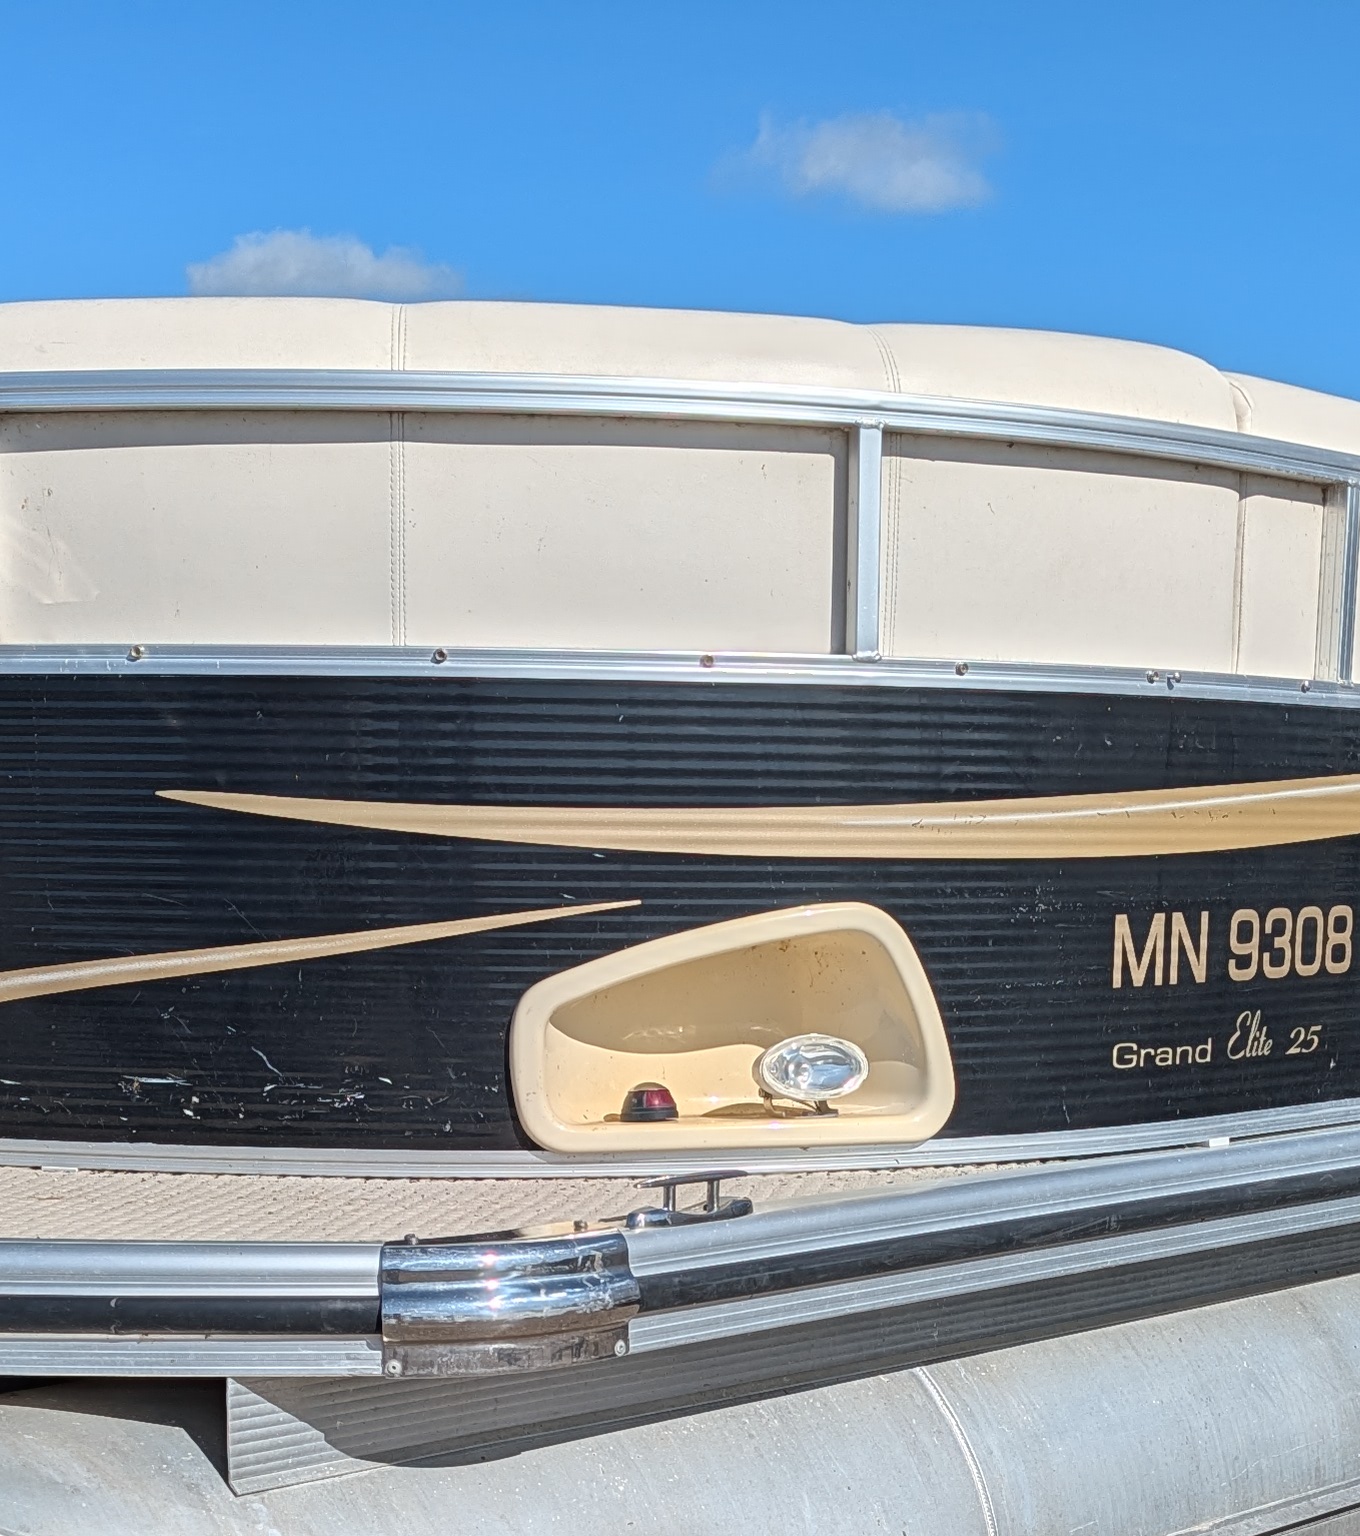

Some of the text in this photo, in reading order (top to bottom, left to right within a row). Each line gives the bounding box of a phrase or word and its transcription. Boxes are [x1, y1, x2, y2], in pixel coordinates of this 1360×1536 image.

[1112, 911, 1209, 988] MN
[1228, 904, 1353, 981] 9308
[1112, 1009, 1323, 1069] Grand Elite 25
